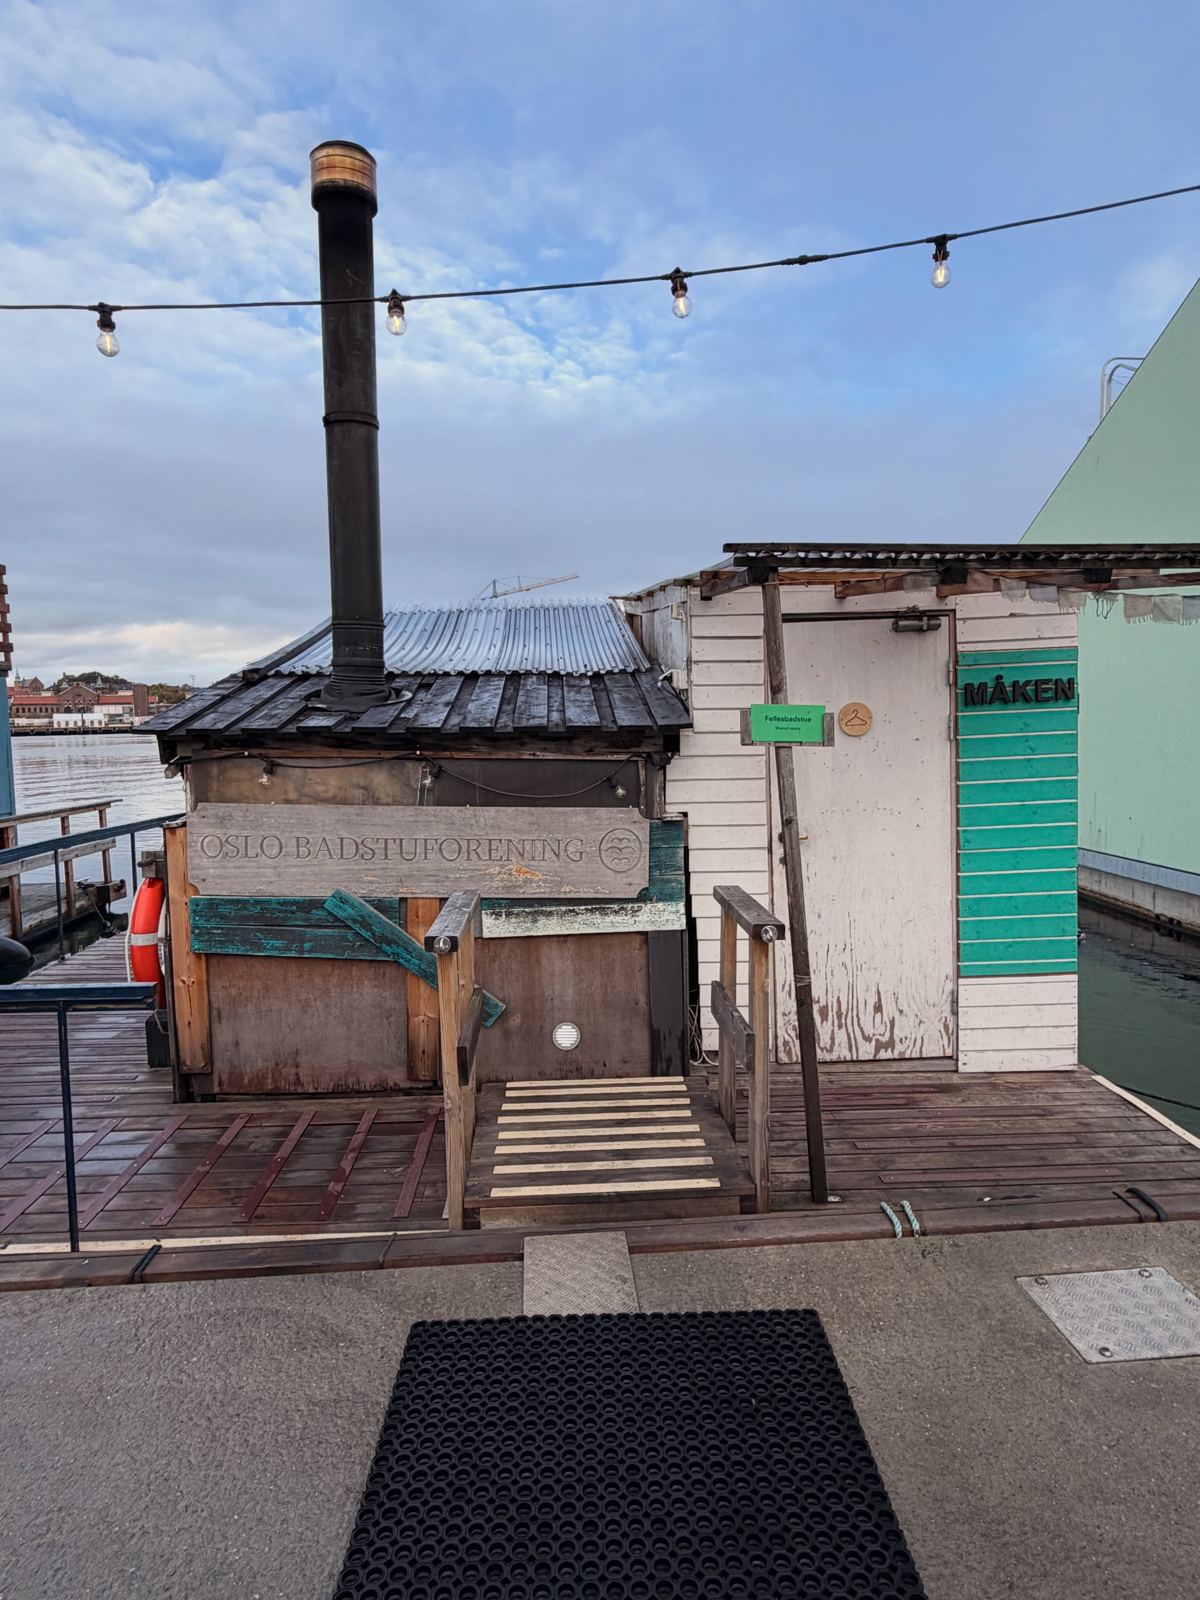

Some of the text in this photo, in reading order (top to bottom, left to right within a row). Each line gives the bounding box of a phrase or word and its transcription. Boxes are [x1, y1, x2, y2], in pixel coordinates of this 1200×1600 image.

[964, 674, 1075, 706] MÅKEN
[764, 715, 812, 723] Fellesbadstue
[200, 834, 584, 862] OSLO BADSTUFORENING
